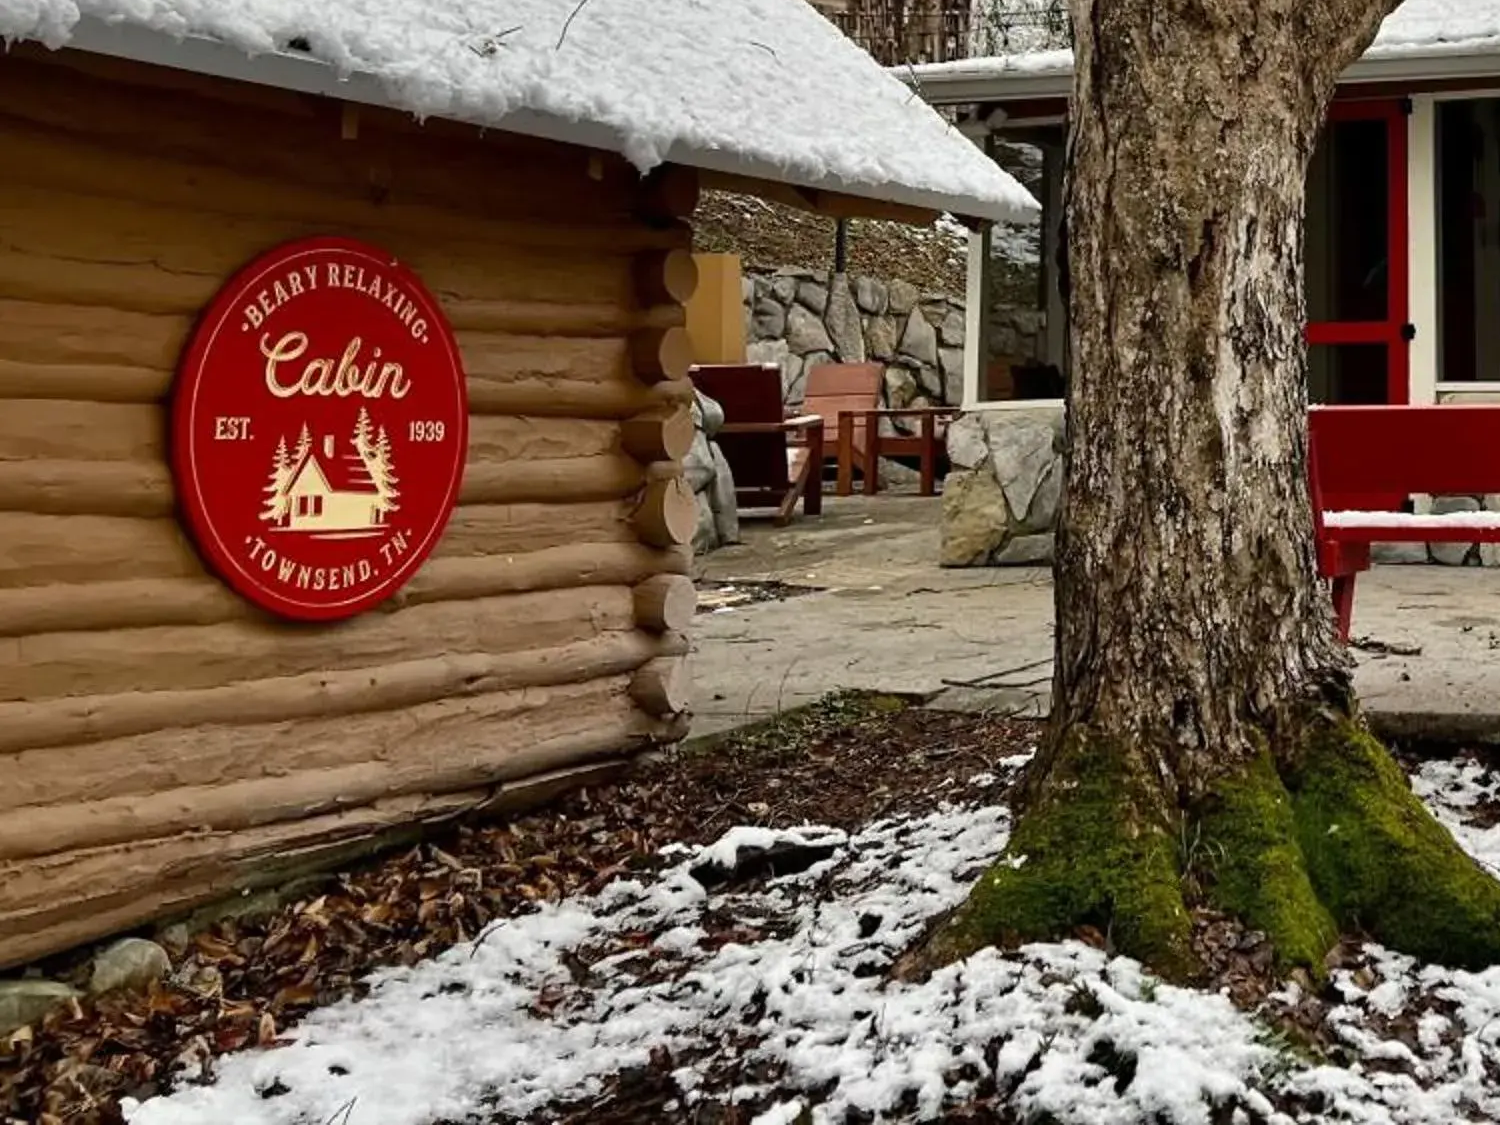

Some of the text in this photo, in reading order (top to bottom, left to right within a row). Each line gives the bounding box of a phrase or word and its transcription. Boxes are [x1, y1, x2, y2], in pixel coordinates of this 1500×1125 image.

[244, 262, 426, 339] BEARY RELAXING
[260, 332, 411, 398] Cabin
[214, 416, 445, 441] EST. 1939
[380, 529, 409, 565] TN
